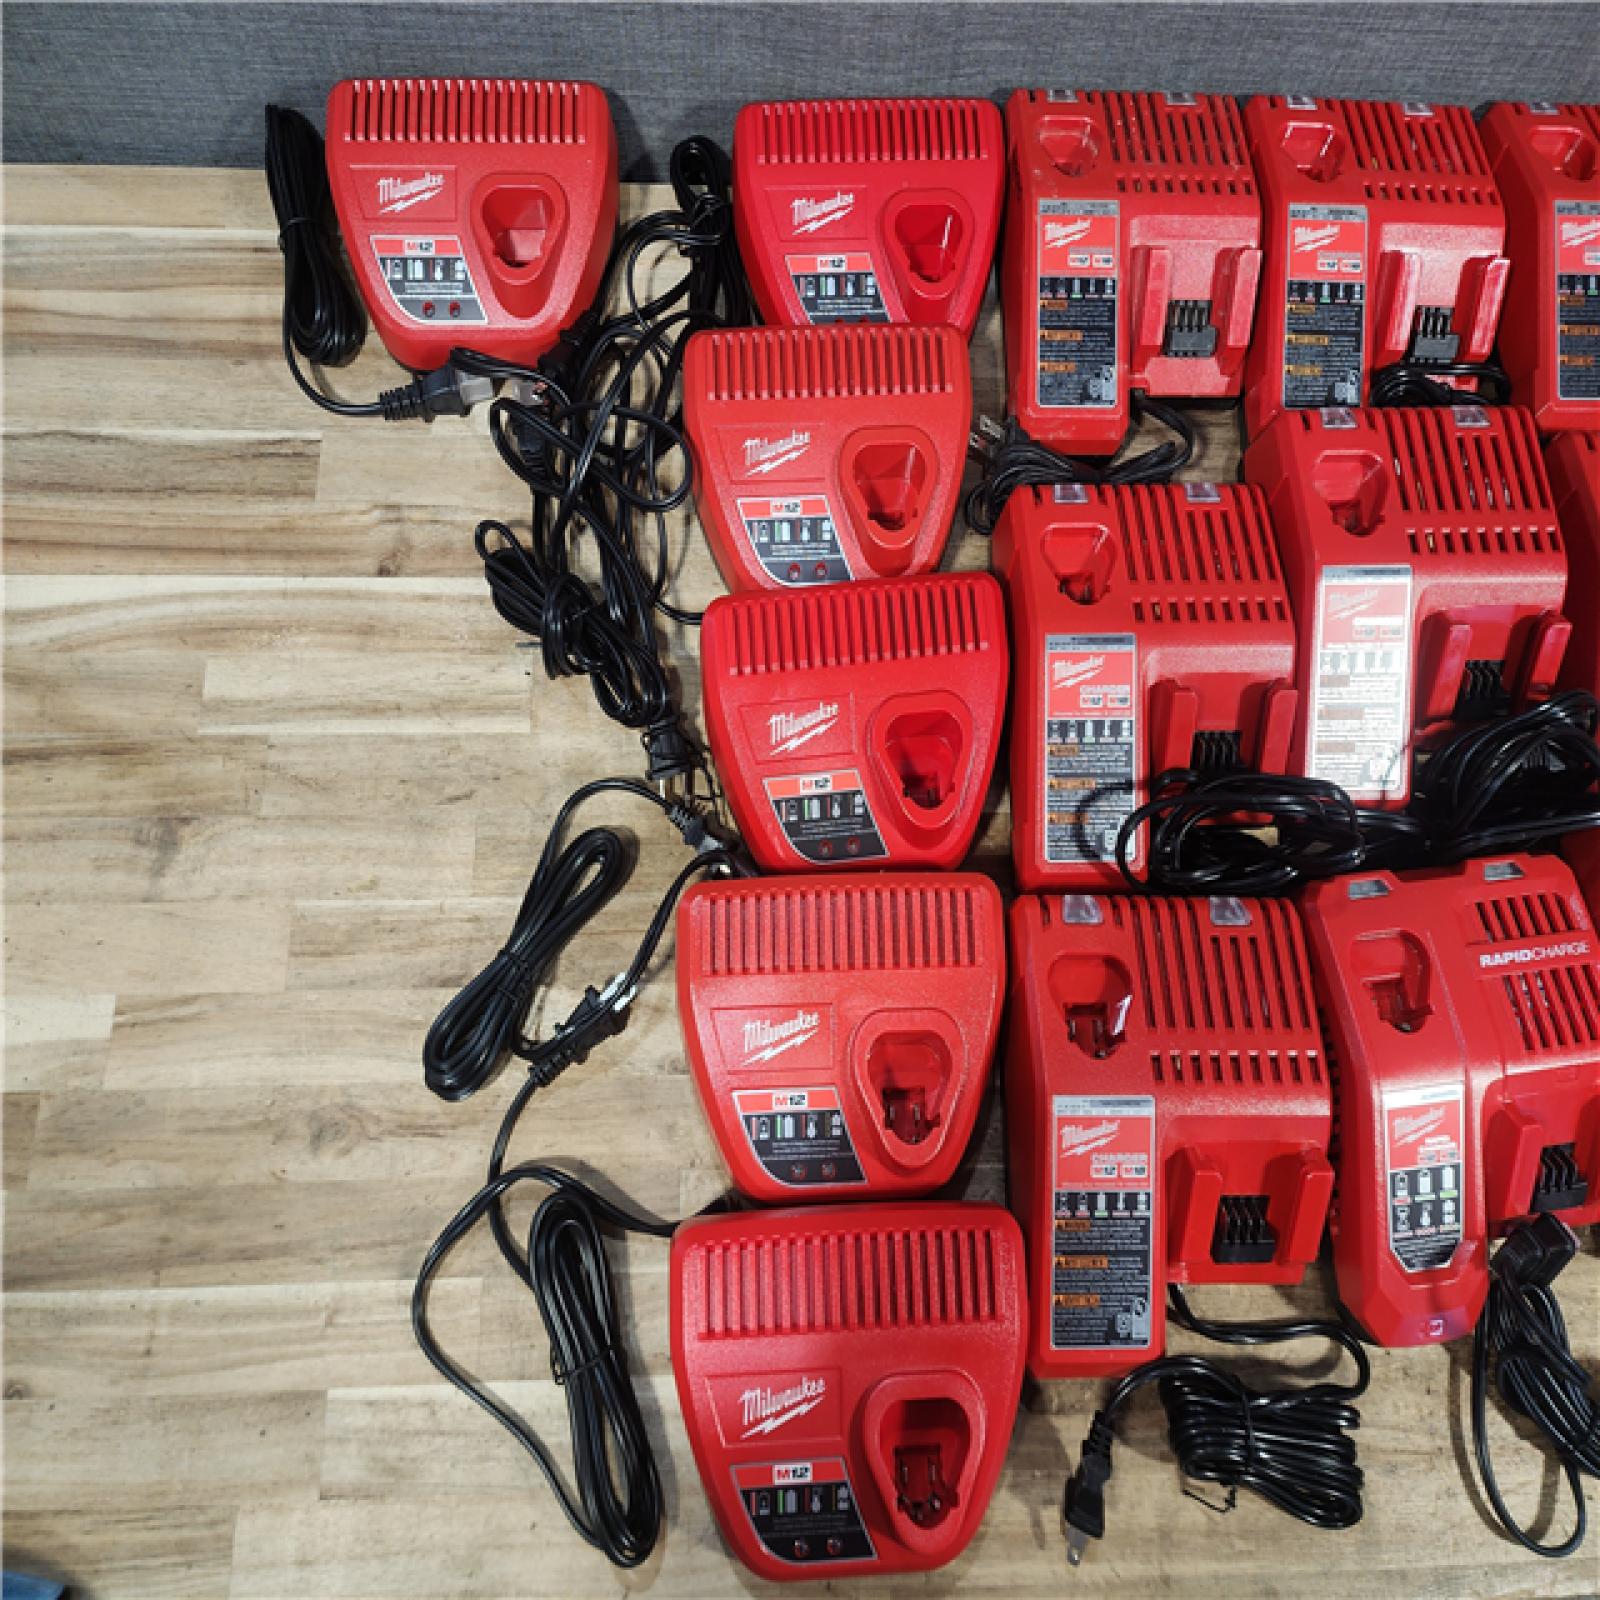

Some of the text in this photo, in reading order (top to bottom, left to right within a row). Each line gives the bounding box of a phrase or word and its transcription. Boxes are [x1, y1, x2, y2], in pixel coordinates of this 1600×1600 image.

[377, 171, 444, 206] Milwaukee
[790, 190, 854, 226] Milwaukee
[742, 429, 811, 466] Milwaukee
[1053, 654, 1106, 684] Milwaukee
[768, 701, 839, 745] Milwaukee
[742, 1009, 820, 1053] Milwaukee
[775, 1093, 806, 1107] M12
[1060, 1119, 1120, 1150] Milwaukee
[738, 1375, 826, 1426] Milwaukee
[776, 1465, 811, 1480] M12
